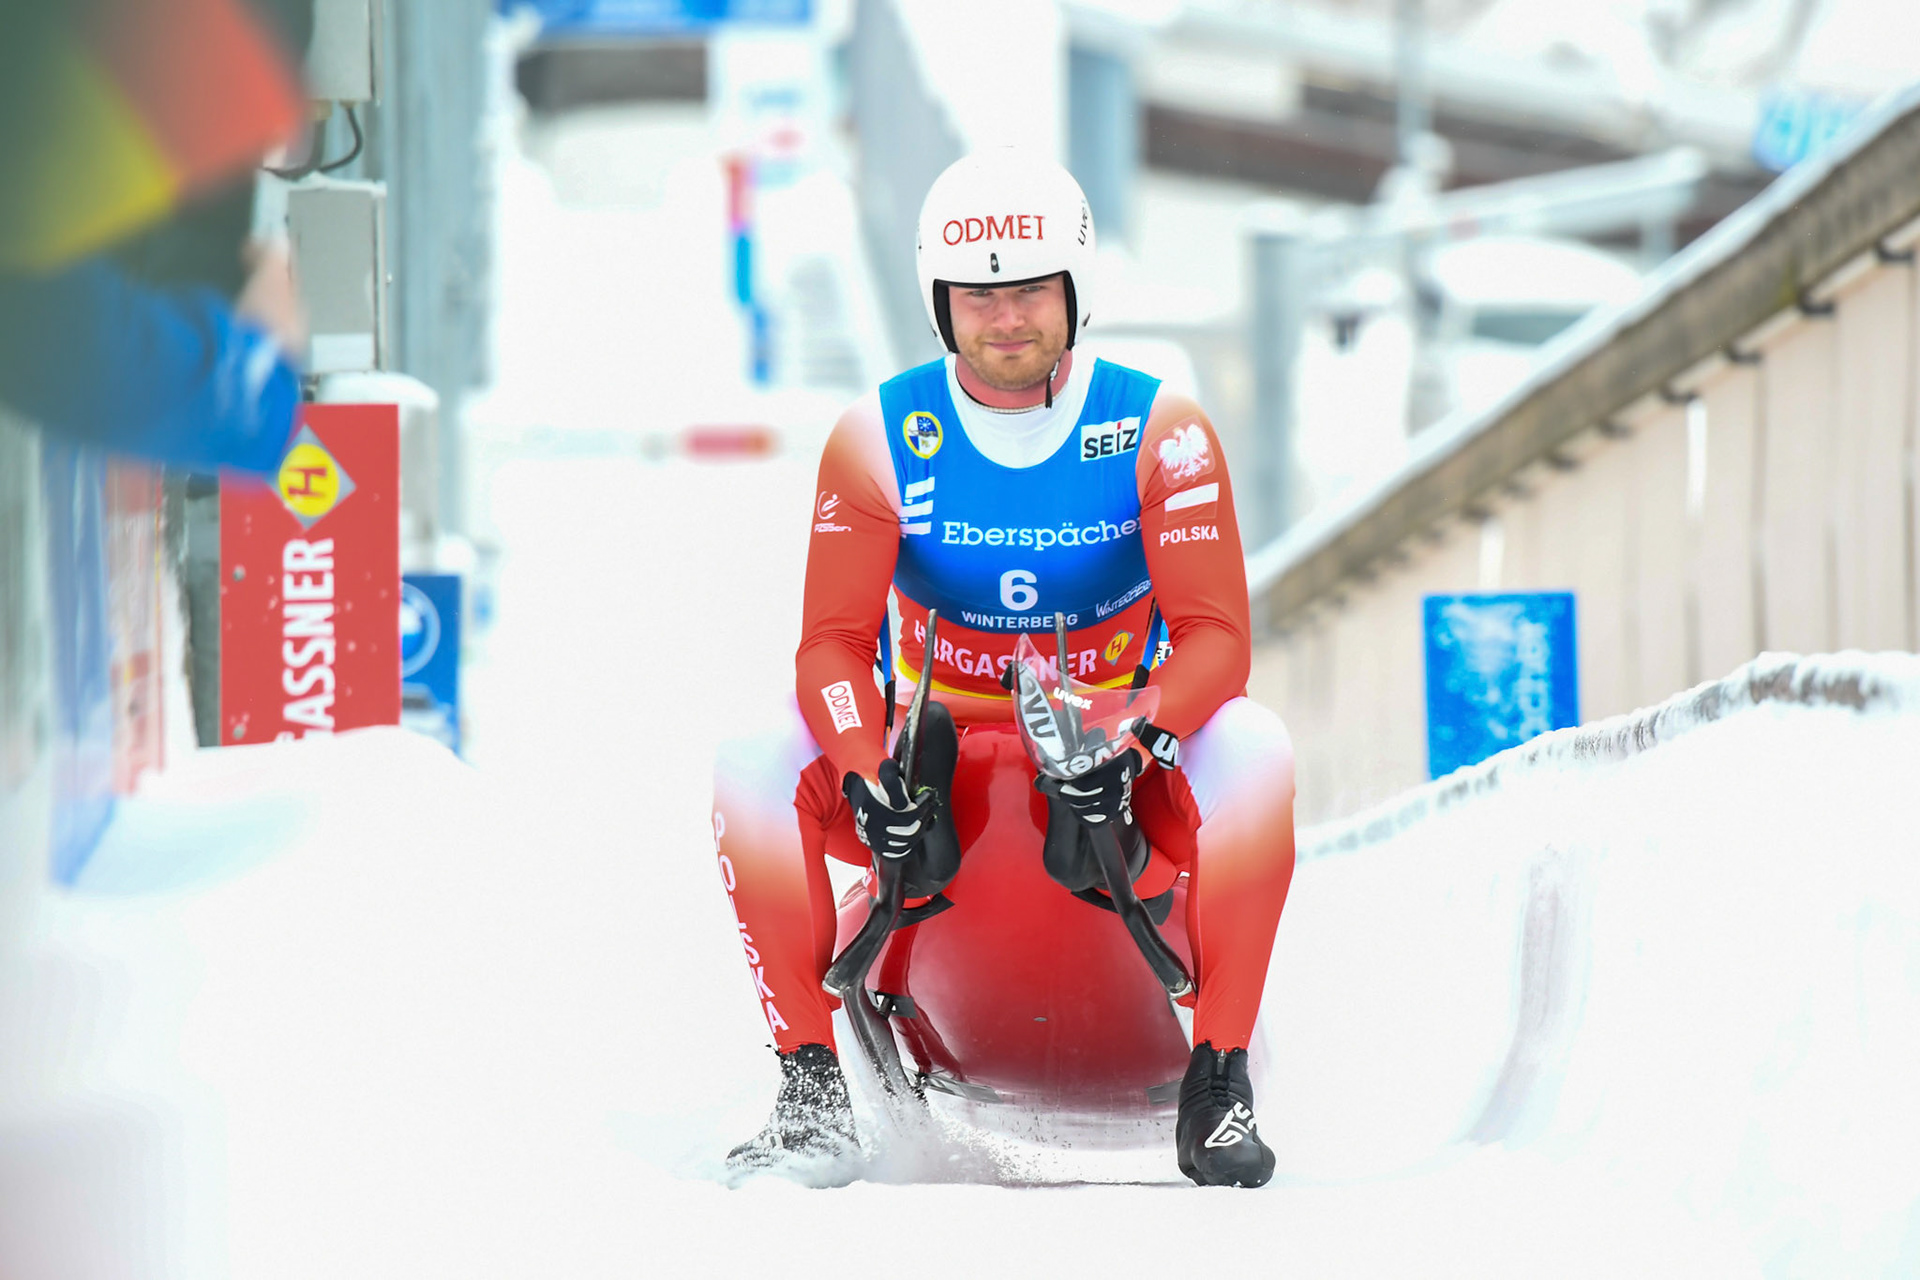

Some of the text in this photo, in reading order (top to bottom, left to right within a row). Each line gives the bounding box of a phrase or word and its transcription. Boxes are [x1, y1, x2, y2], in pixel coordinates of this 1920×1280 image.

[943, 214, 1045, 246] ODMET
[1159, 525, 1220, 547] POLSKA
[1000, 569, 1038, 611] 6
[961, 610, 1079, 629] WINTERBEG
[828, 684, 857, 728] ODMET
[1053, 686, 1093, 710] uvex
[714, 811, 790, 1035] POLSKA
